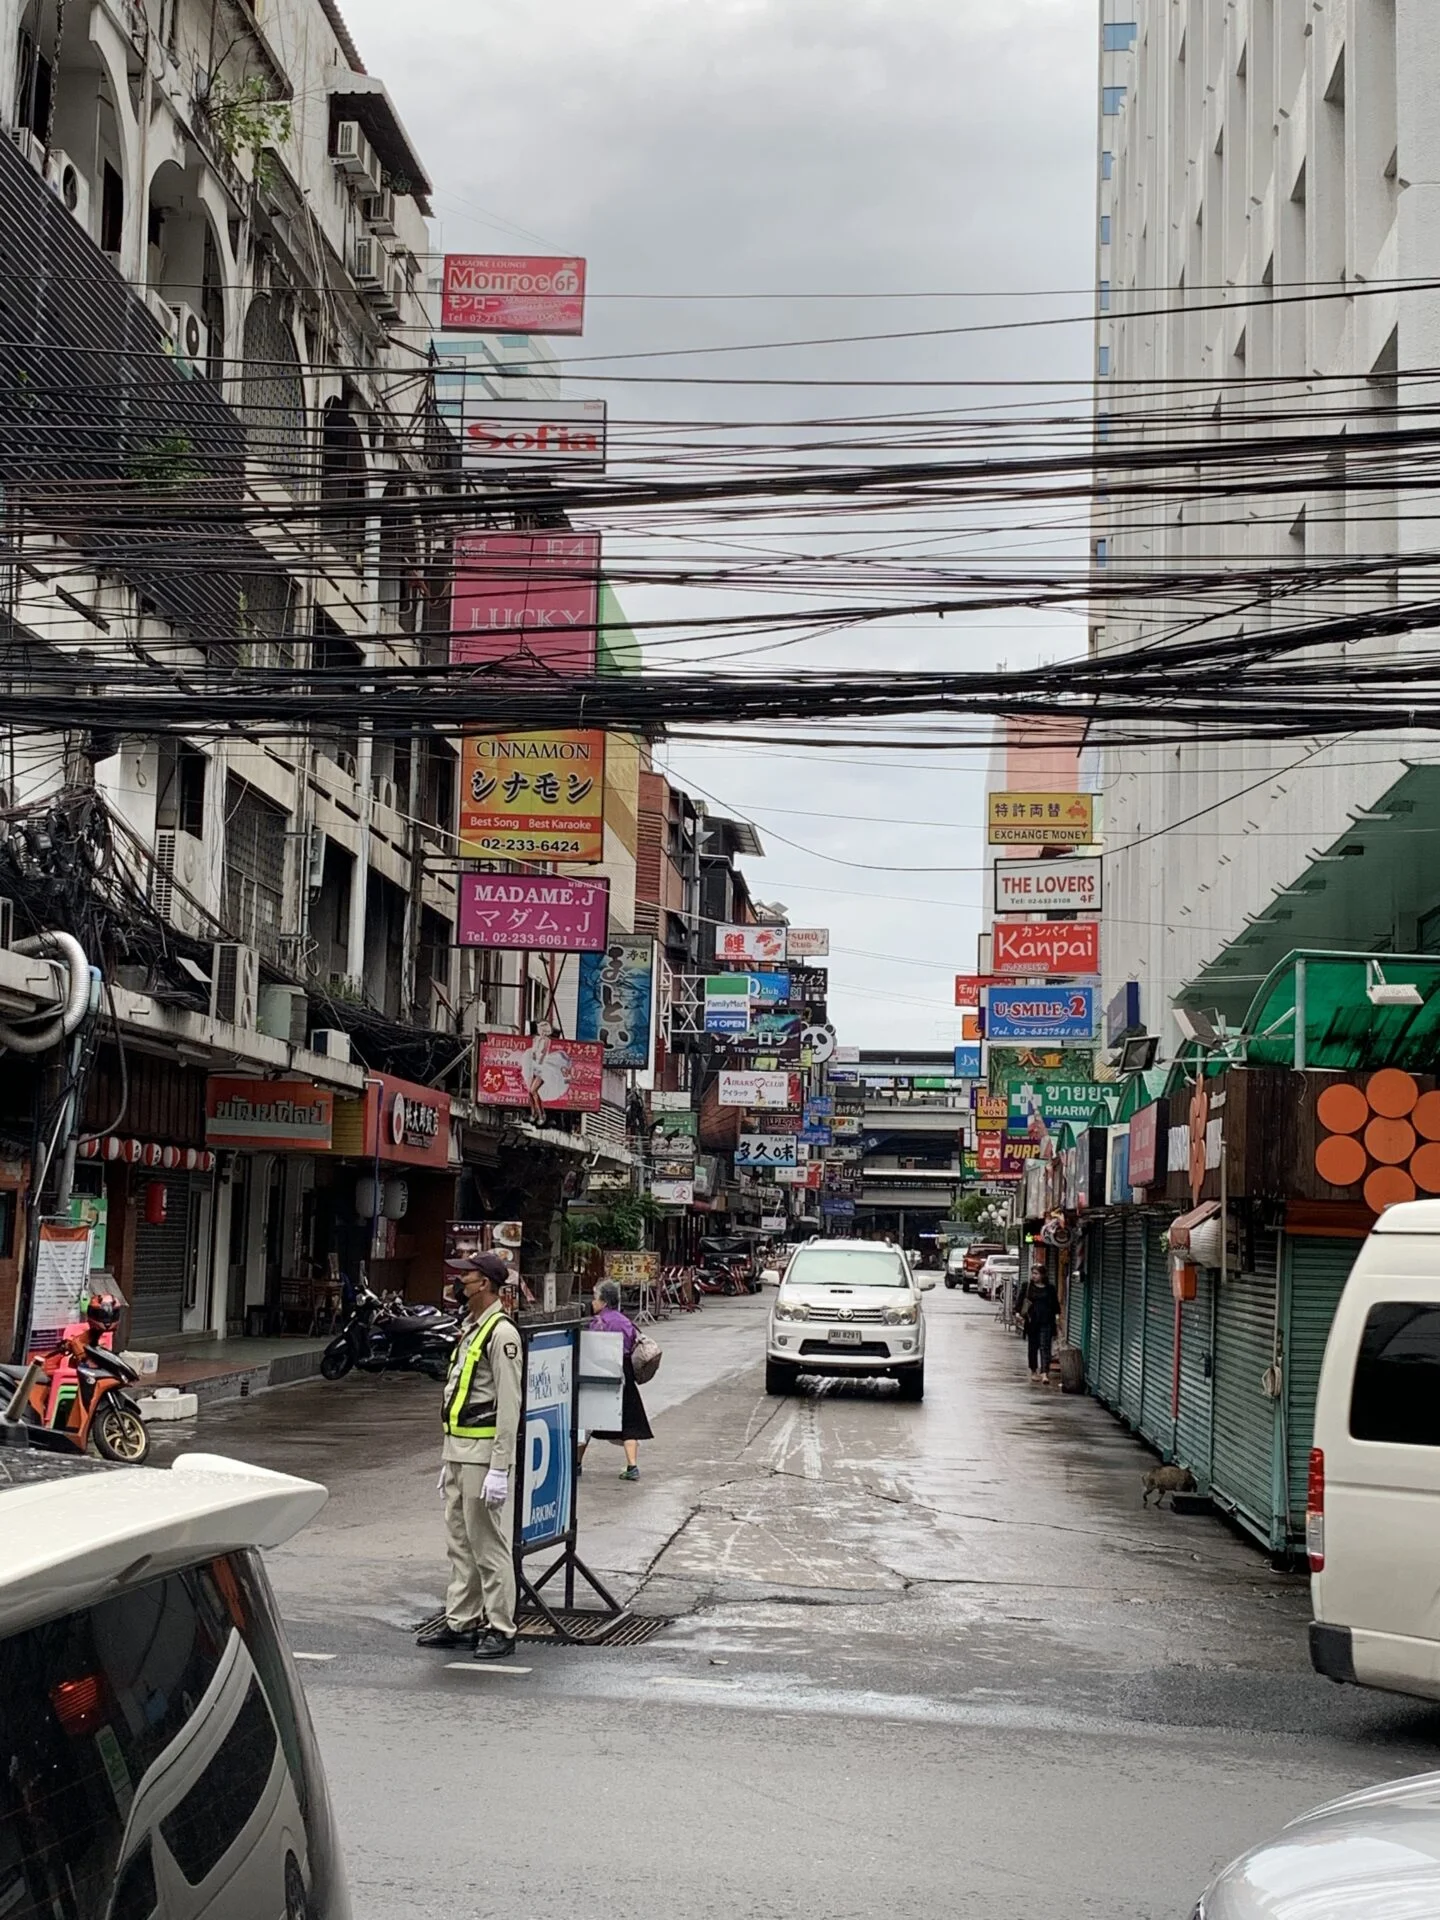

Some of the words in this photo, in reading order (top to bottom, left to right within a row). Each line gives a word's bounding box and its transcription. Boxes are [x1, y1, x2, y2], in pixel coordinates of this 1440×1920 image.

[450, 260, 489, 269] KARAOKE
[492, 262, 527, 270] LOUNGE
[449, 267, 552, 292] Monroe
[555, 275, 578, 292] 6F
[449, 295, 499, 310] モンロー
[467, 423, 598, 451] Sofia
[471, 608, 585, 630] LUCKY
[476, 741, 591, 761] CINNAMON
[472, 769, 594, 803] シナモン
[994, 803, 1061, 818] 特許両替
[470, 817, 492, 827] Best
[493, 818, 519, 830] Song
[529, 819, 550, 829] Best
[551, 820, 592, 830] Karaoke
[994, 829, 1049, 841] EXCHANGE
[1052, 830, 1088, 841] MONEY
[481, 839, 580, 853] 02-233-6424
[1002, 877, 1032, 894] THE
[1036, 876, 1095, 893] LOVERS
[1080, 895, 1095, 904] 4F
[467, 931, 488, 942] Tel.
[1022, 926, 1069, 937] カンパイ
[998, 931, 1093, 966] Kanpai
[707, 1000, 746, 1010] FamilyMart
[707, 1020, 718, 1028] 24
[719, 1020, 745, 1028] OPEN
[992, 1027, 1010, 1036] Tel.
[485, 1037, 526, 1051] Marilyn
[715, 1045, 727, 1054] 3F
[737, 1141, 794, 1162] 多久味
[522, 1418, 551, 1529] P
